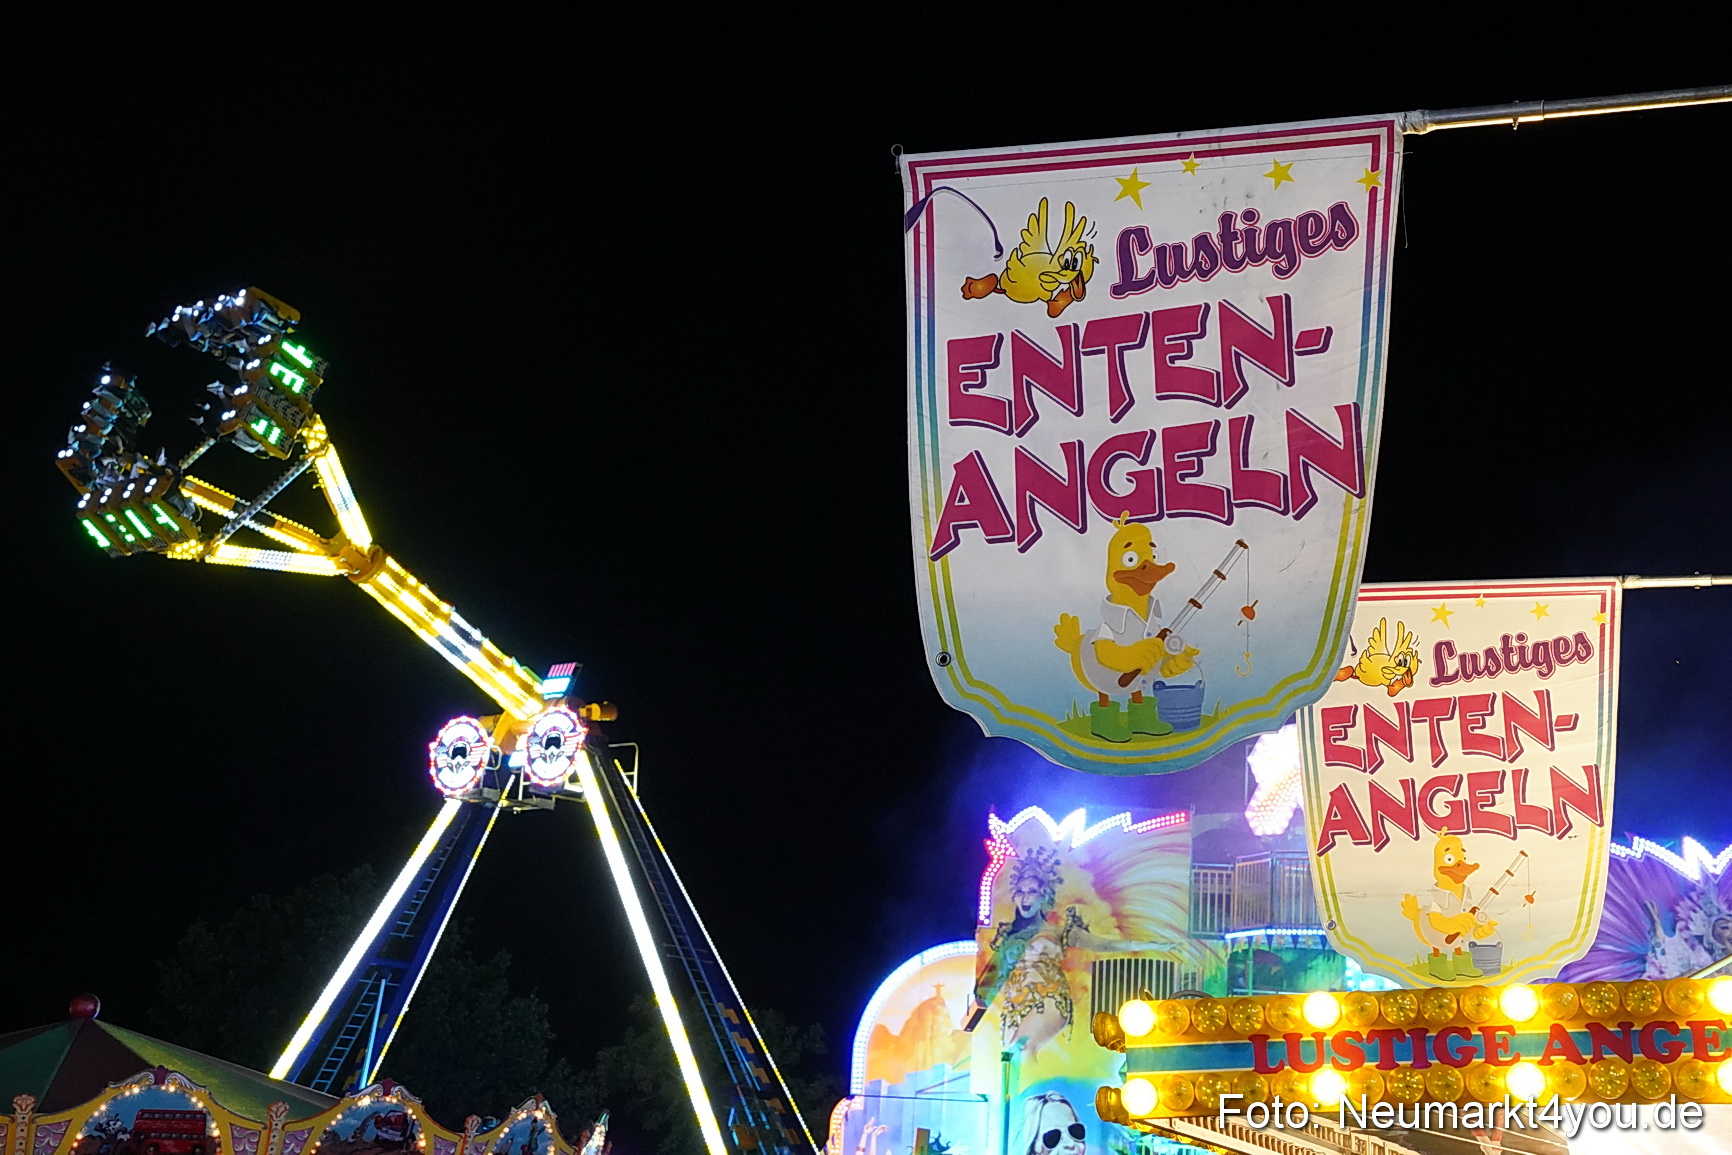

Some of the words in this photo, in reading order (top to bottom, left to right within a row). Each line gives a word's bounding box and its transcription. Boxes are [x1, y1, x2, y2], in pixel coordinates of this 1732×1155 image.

[1111, 202, 1360, 300] Lustiges
[947, 293, 1333, 437] ENTEN-
[930, 402, 1365, 561] ANGELN
[1429, 631, 1594, 687] Lustiges
[1320, 689, 1579, 774] ENTEN-
[1316, 764, 1604, 857] ANGELN
[1247, 1024, 1520, 1074] LUSTIGE
[1538, 1019, 1732, 1066] ANGE
